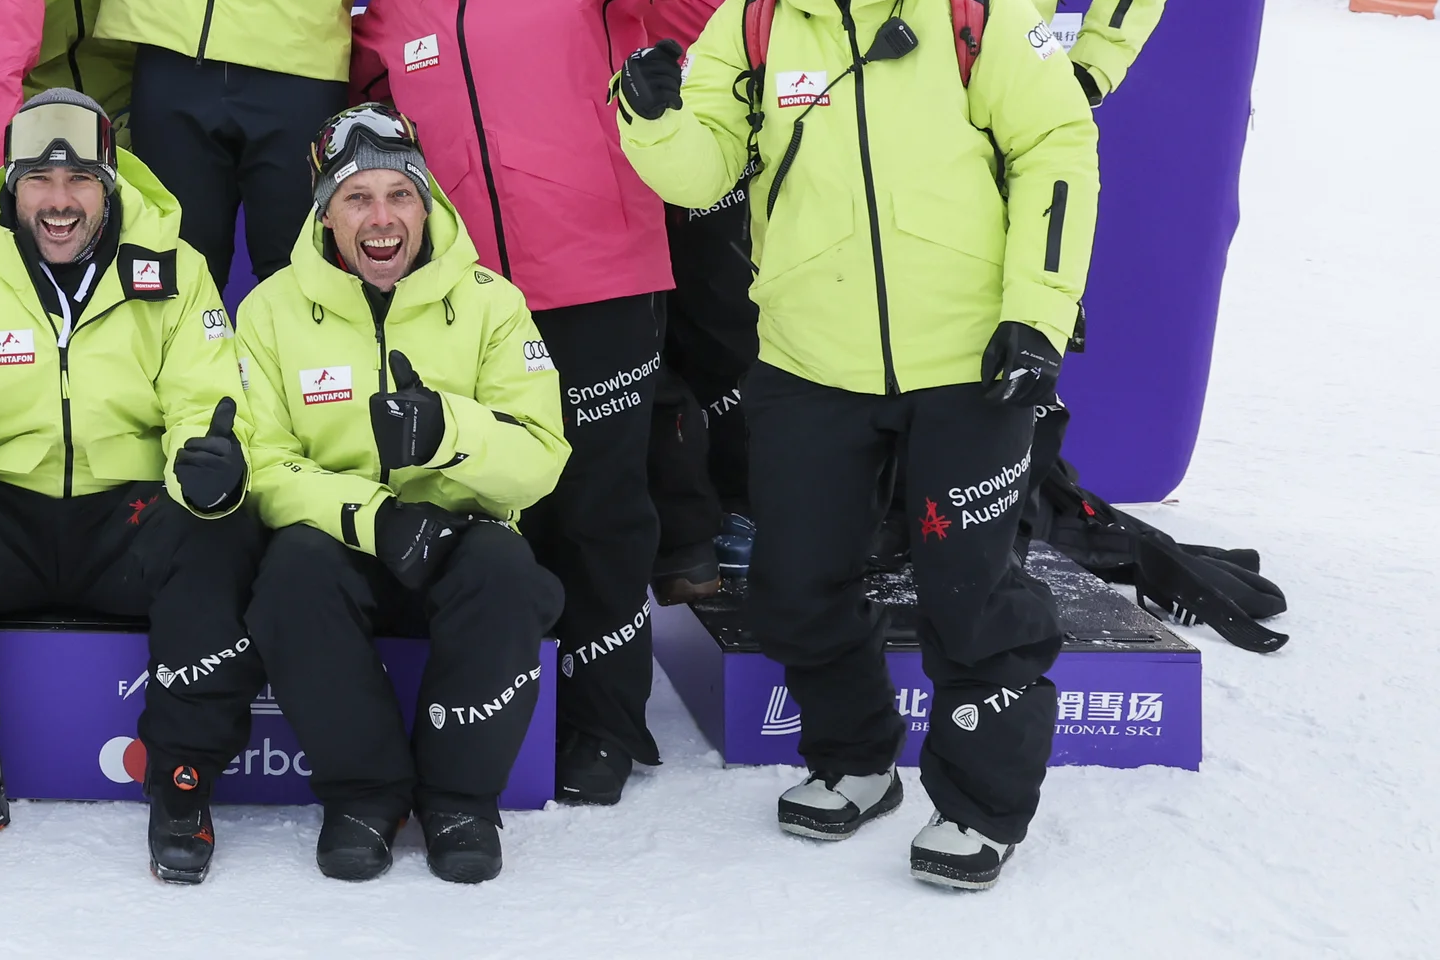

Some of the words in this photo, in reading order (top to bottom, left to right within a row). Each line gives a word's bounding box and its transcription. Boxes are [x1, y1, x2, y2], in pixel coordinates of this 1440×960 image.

[406, 57, 438, 72] MONTAFON
[527, 362, 546, 372] Audi
[567, 351, 660, 405] Snowboard
[305, 391, 350, 402] MONTAFON
[576, 391, 642, 427] Austria
[961, 489, 1019, 530] Austria
[575, 598, 651, 665] TANBOE
[174, 637, 252, 686] TANBO
[451, 664, 542, 725] TANBOE
[1124, 725, 1162, 737] SKI
